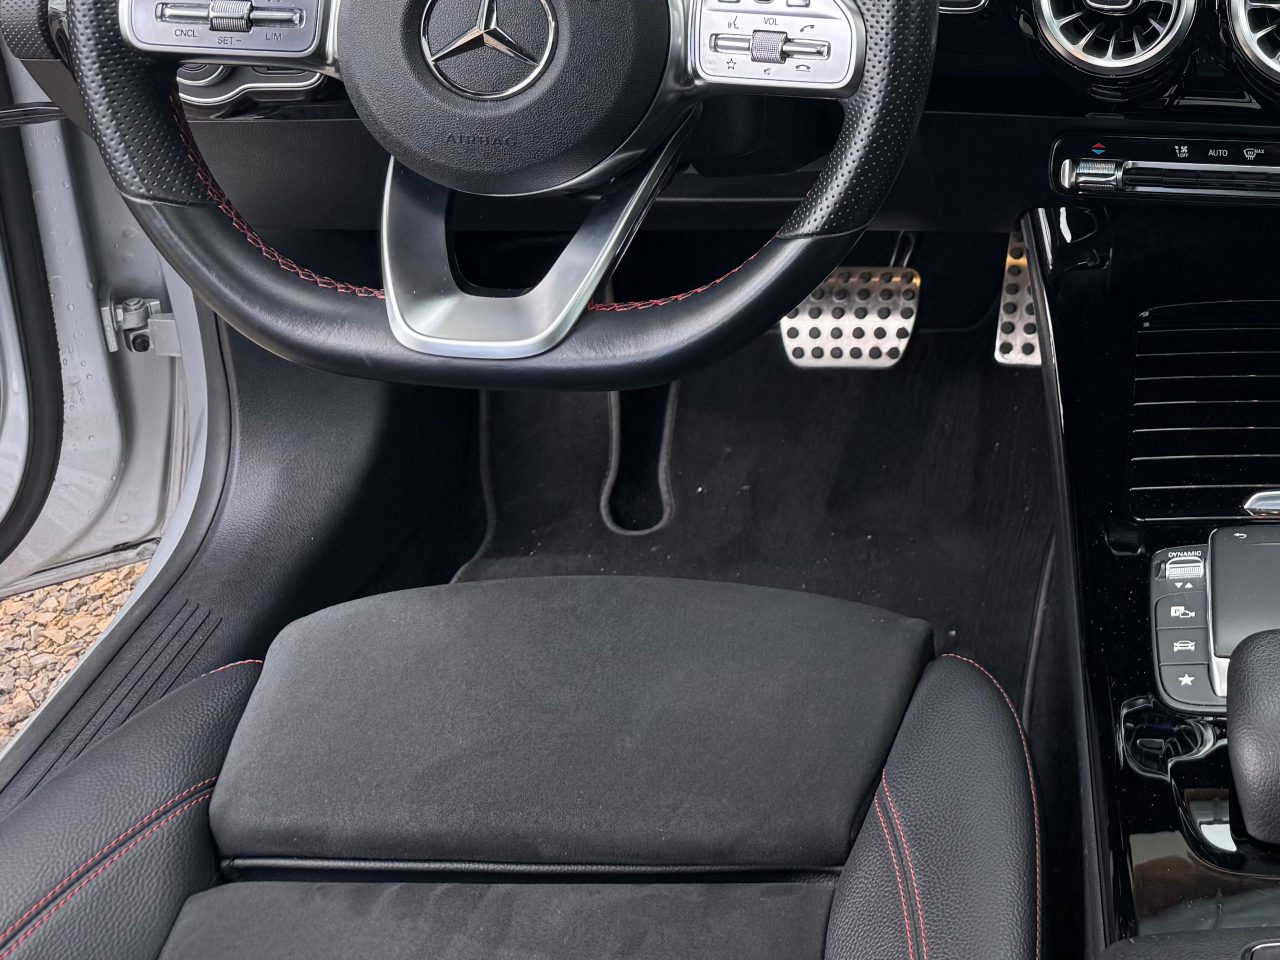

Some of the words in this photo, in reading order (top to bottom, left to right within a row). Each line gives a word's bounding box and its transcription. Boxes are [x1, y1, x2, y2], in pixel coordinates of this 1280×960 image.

[763, 17, 779, 26] VOL
[174, 28, 198, 38] CNCL
[217, 36, 235, 45] SET
[1208, 149, 1229, 157] AUTO
[1168, 550, 1202, 558] DYNAMIC
